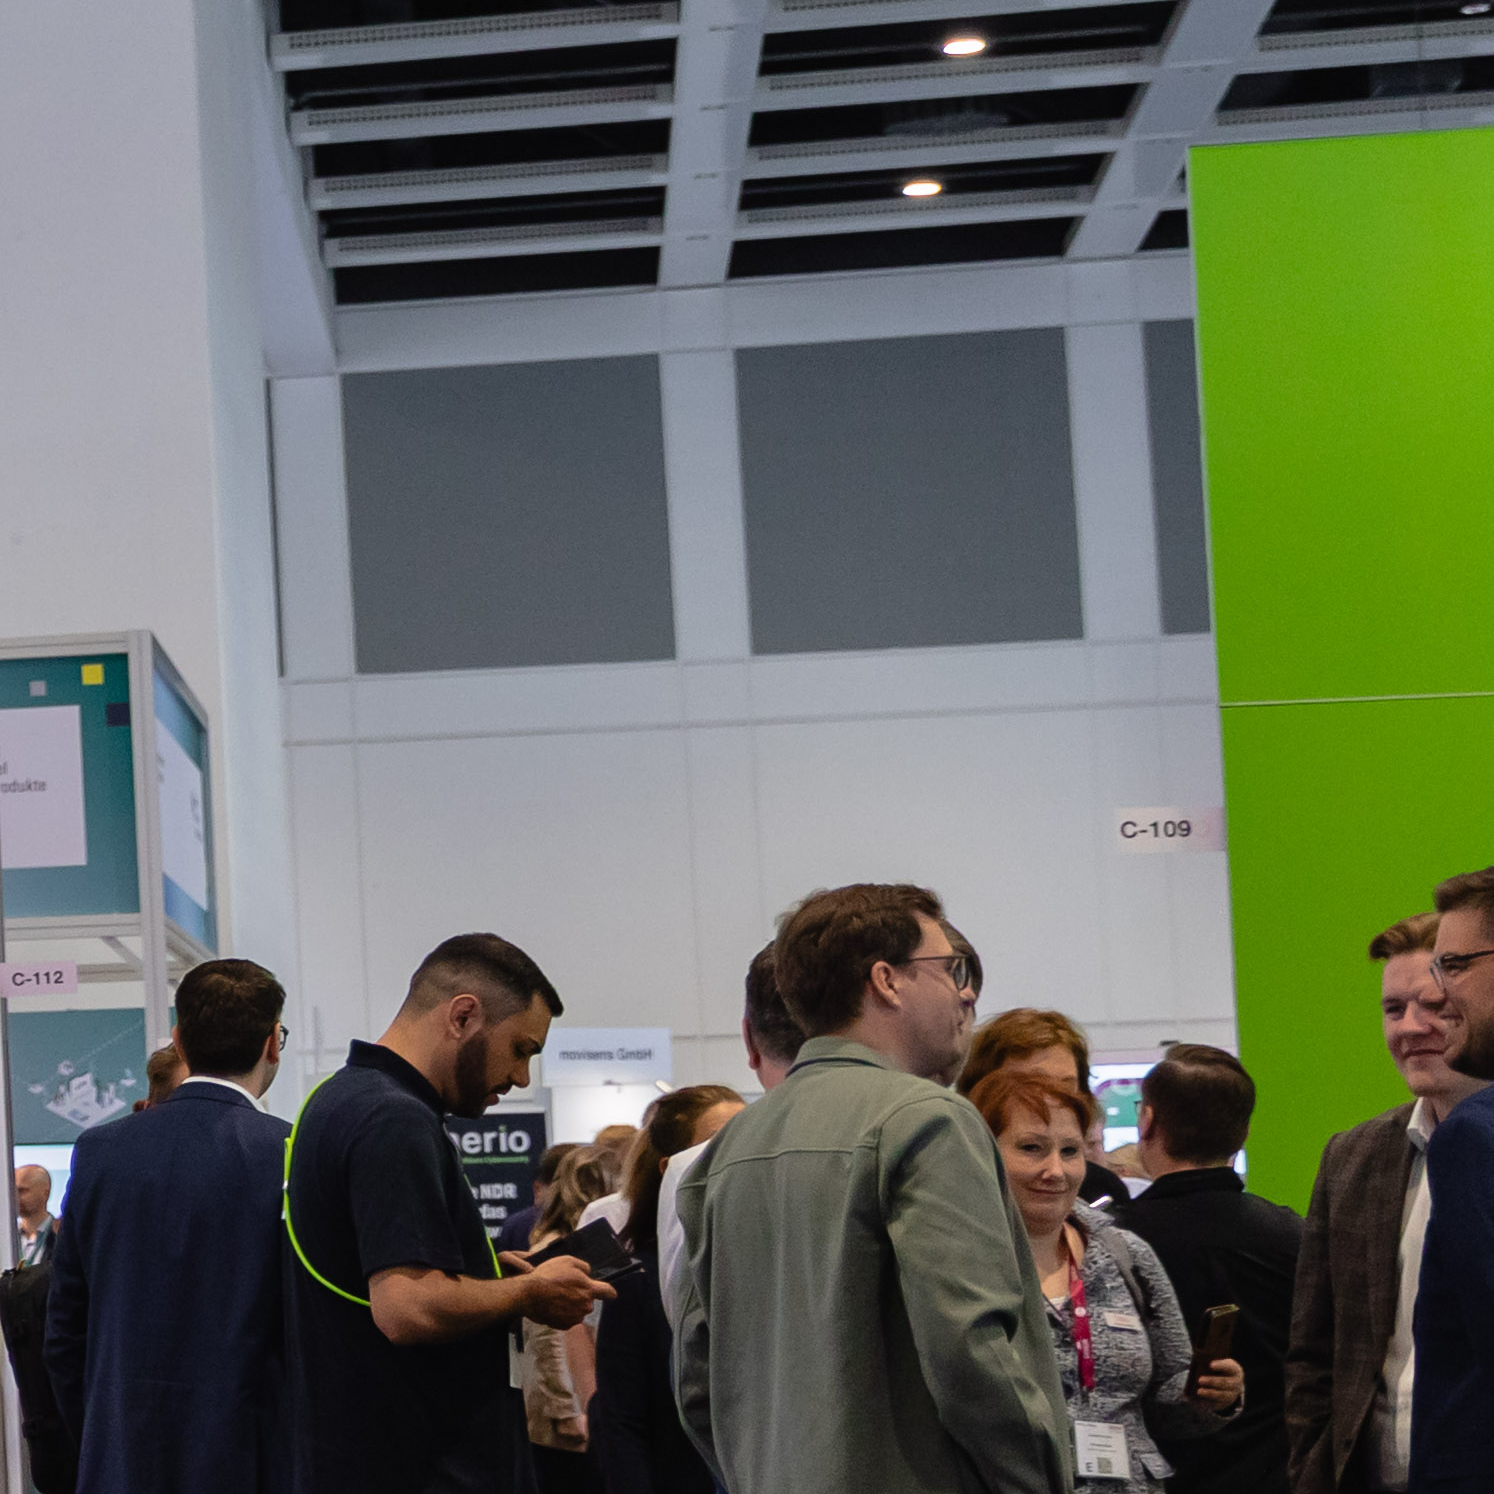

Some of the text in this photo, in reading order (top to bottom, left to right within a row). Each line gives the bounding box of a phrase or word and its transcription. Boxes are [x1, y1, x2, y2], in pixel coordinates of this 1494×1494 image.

[1120, 819, 1192, 839] C-109
[11, 969, 64, 988] C-112
[559, 1049, 652, 1060] movisens GmbH
